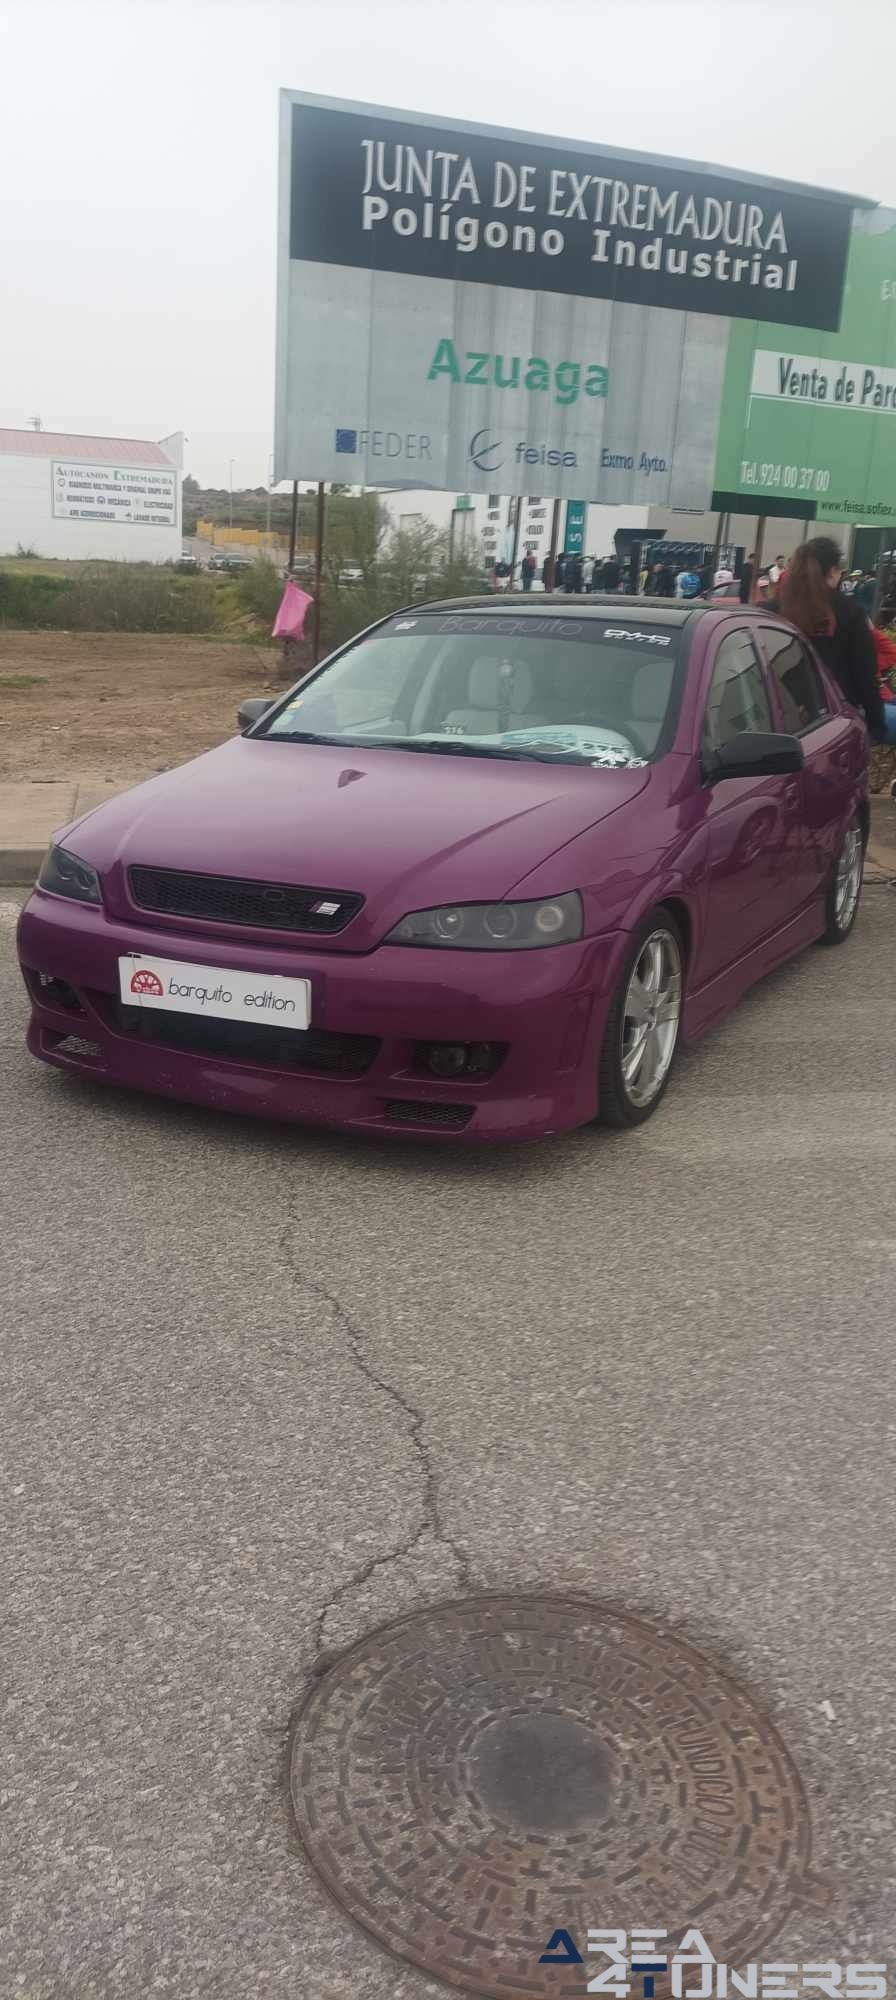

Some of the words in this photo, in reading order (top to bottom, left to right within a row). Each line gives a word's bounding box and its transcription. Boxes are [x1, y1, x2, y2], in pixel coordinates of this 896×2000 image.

[360, 139, 481, 204] JUNTA
[493, 160, 537, 212] DE
[547, 170, 788, 253] EXTREMADURA
[362, 195, 564, 256] Polígono
[591, 228, 798, 290] Industrial
[426, 339, 610, 406] Azuaga
[778, 356, 829, 401] Venta
[834, 366, 856, 402] de
[359, 430, 432, 460] FEDER
[515, 442, 578, 468] feisa
[761, 463, 782, 487] 924
[783, 465, 798, 489] 00
[815, 470, 831, 492] 00
[438, 616, 583, 636] Barquito
[168, 977, 233, 1005] barquito
[243, 991, 296, 1012] edition
